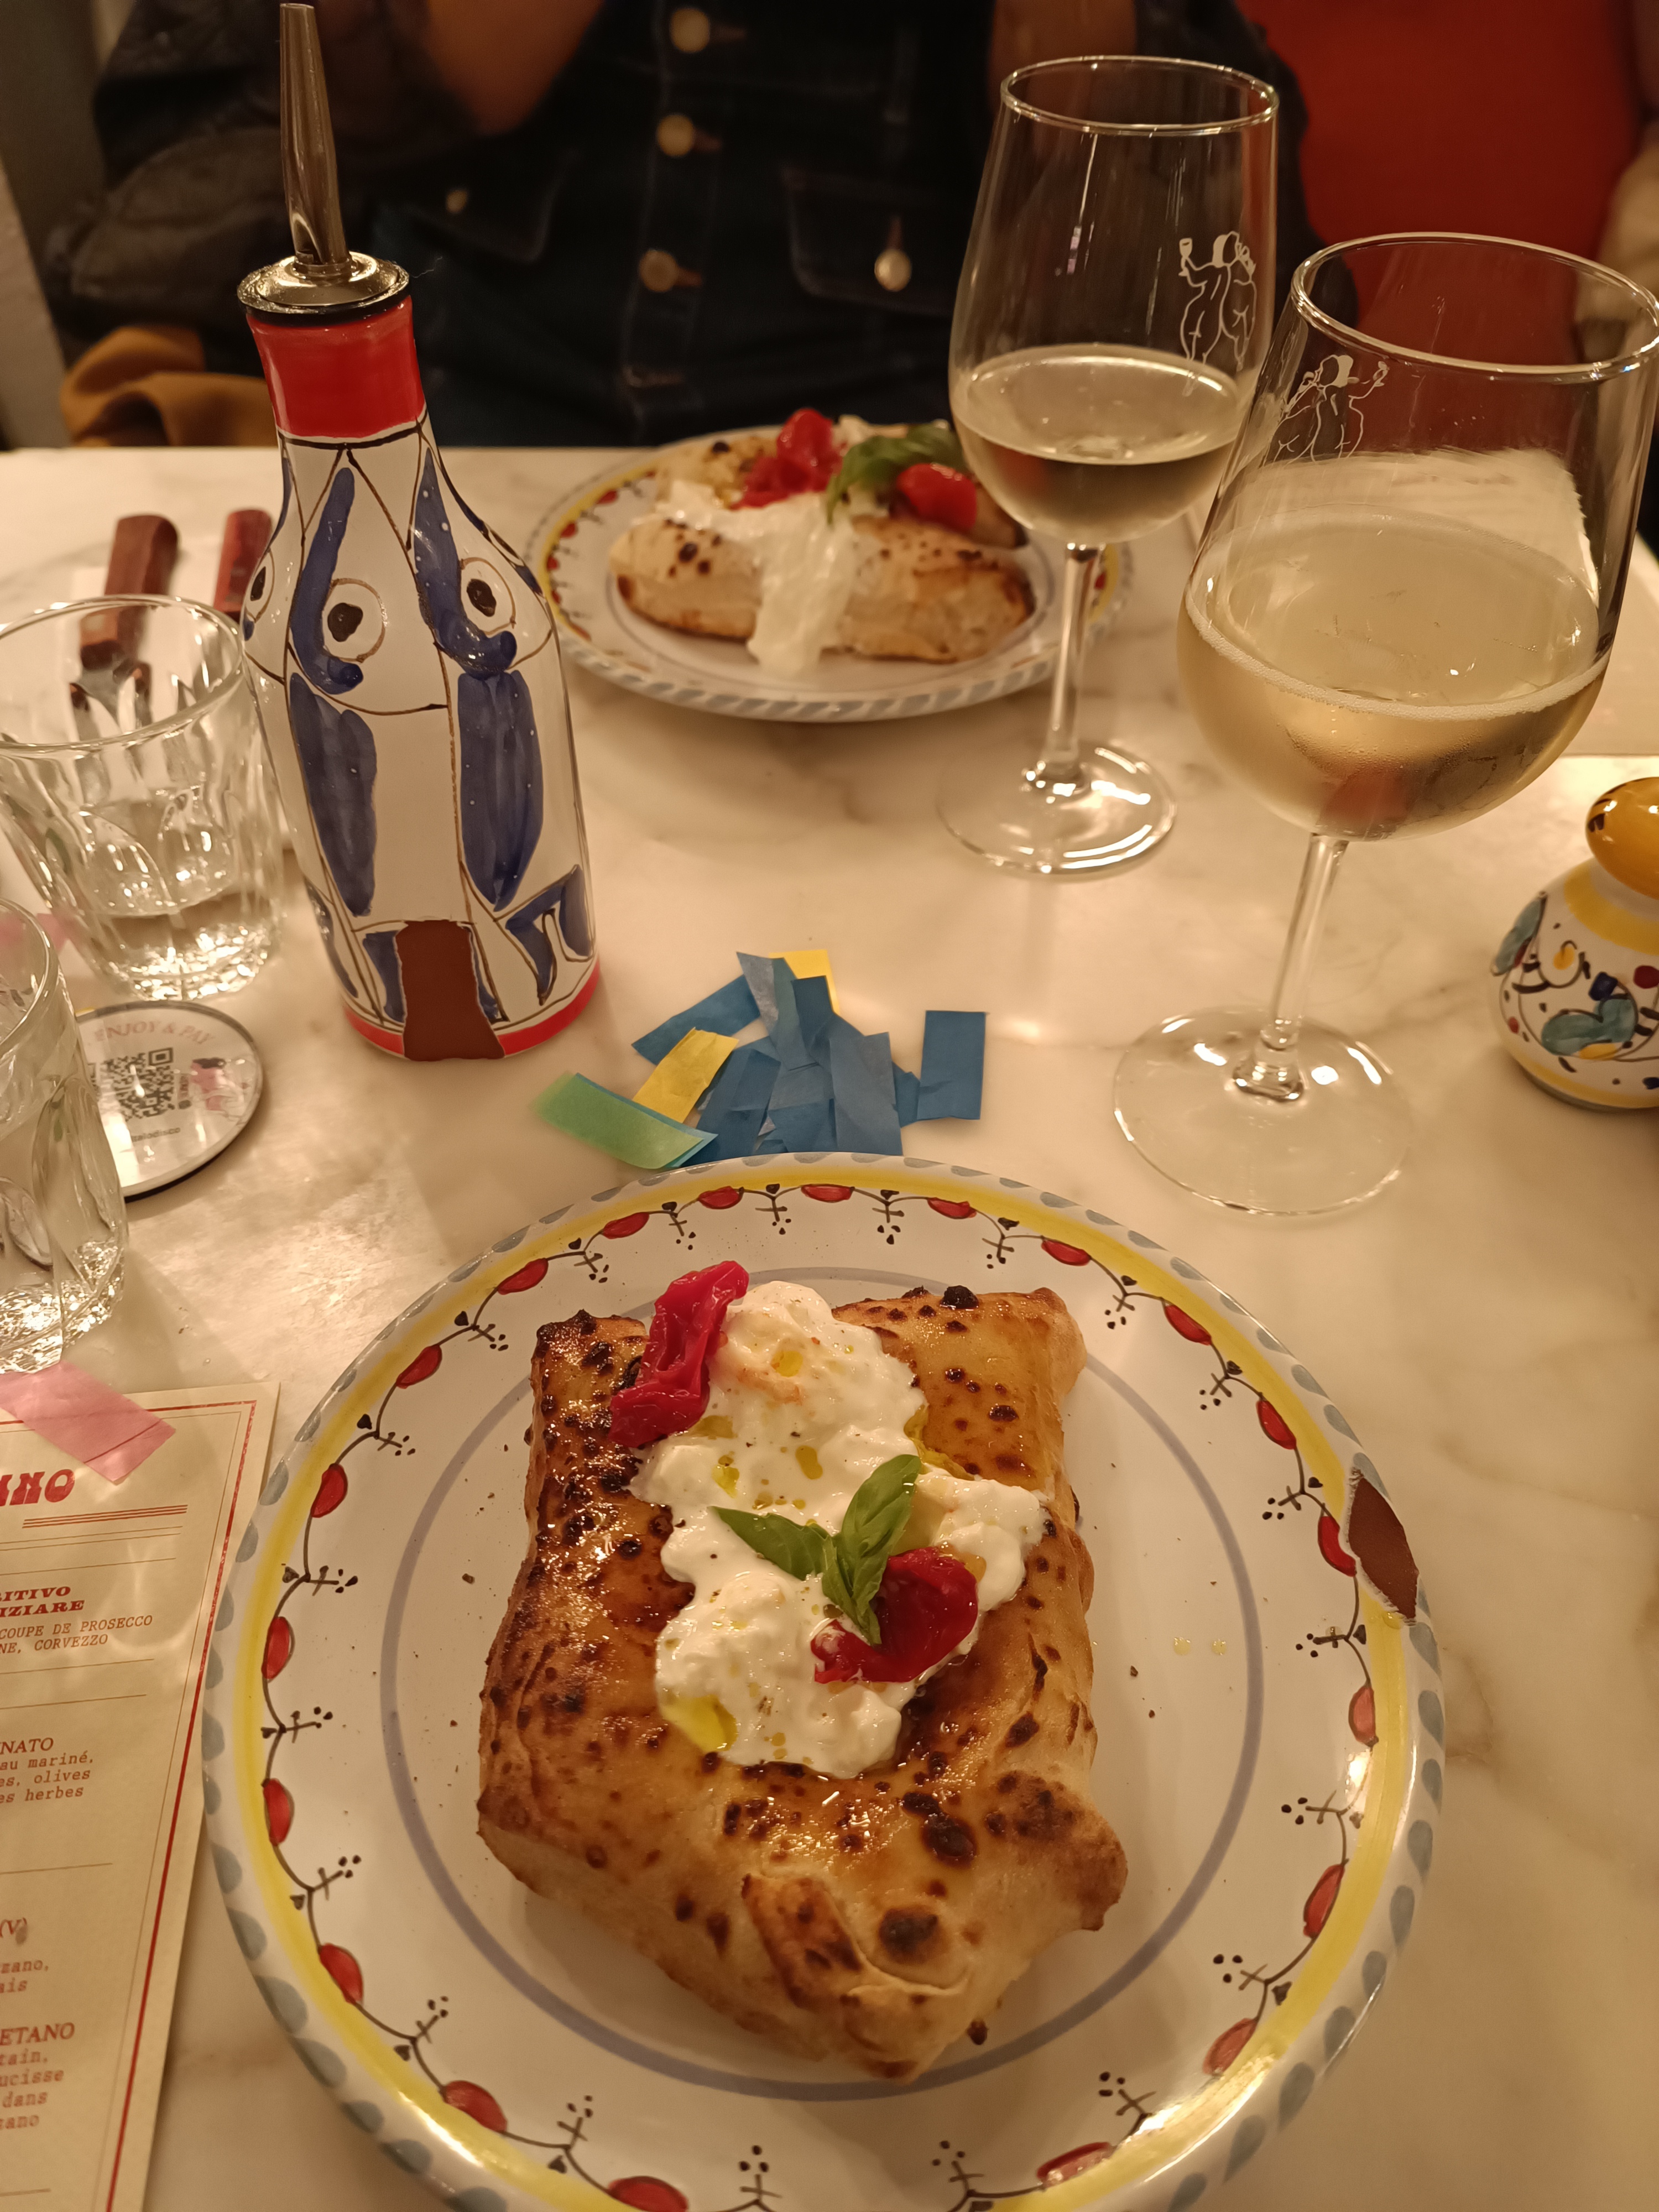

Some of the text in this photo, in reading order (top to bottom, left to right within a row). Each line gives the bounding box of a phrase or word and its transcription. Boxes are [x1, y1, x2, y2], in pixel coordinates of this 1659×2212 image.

[0, 1586, 71, 1602] ITIVO
[0, 1615, 153, 1640] COUPE DE PROSECCO
[34, 1634, 108, 1651] CORVEZZO
[34, 1769, 91, 1784] olives
[25, 1786, 84, 1802] herbes
[0, 2022, 75, 2046] ETANO
